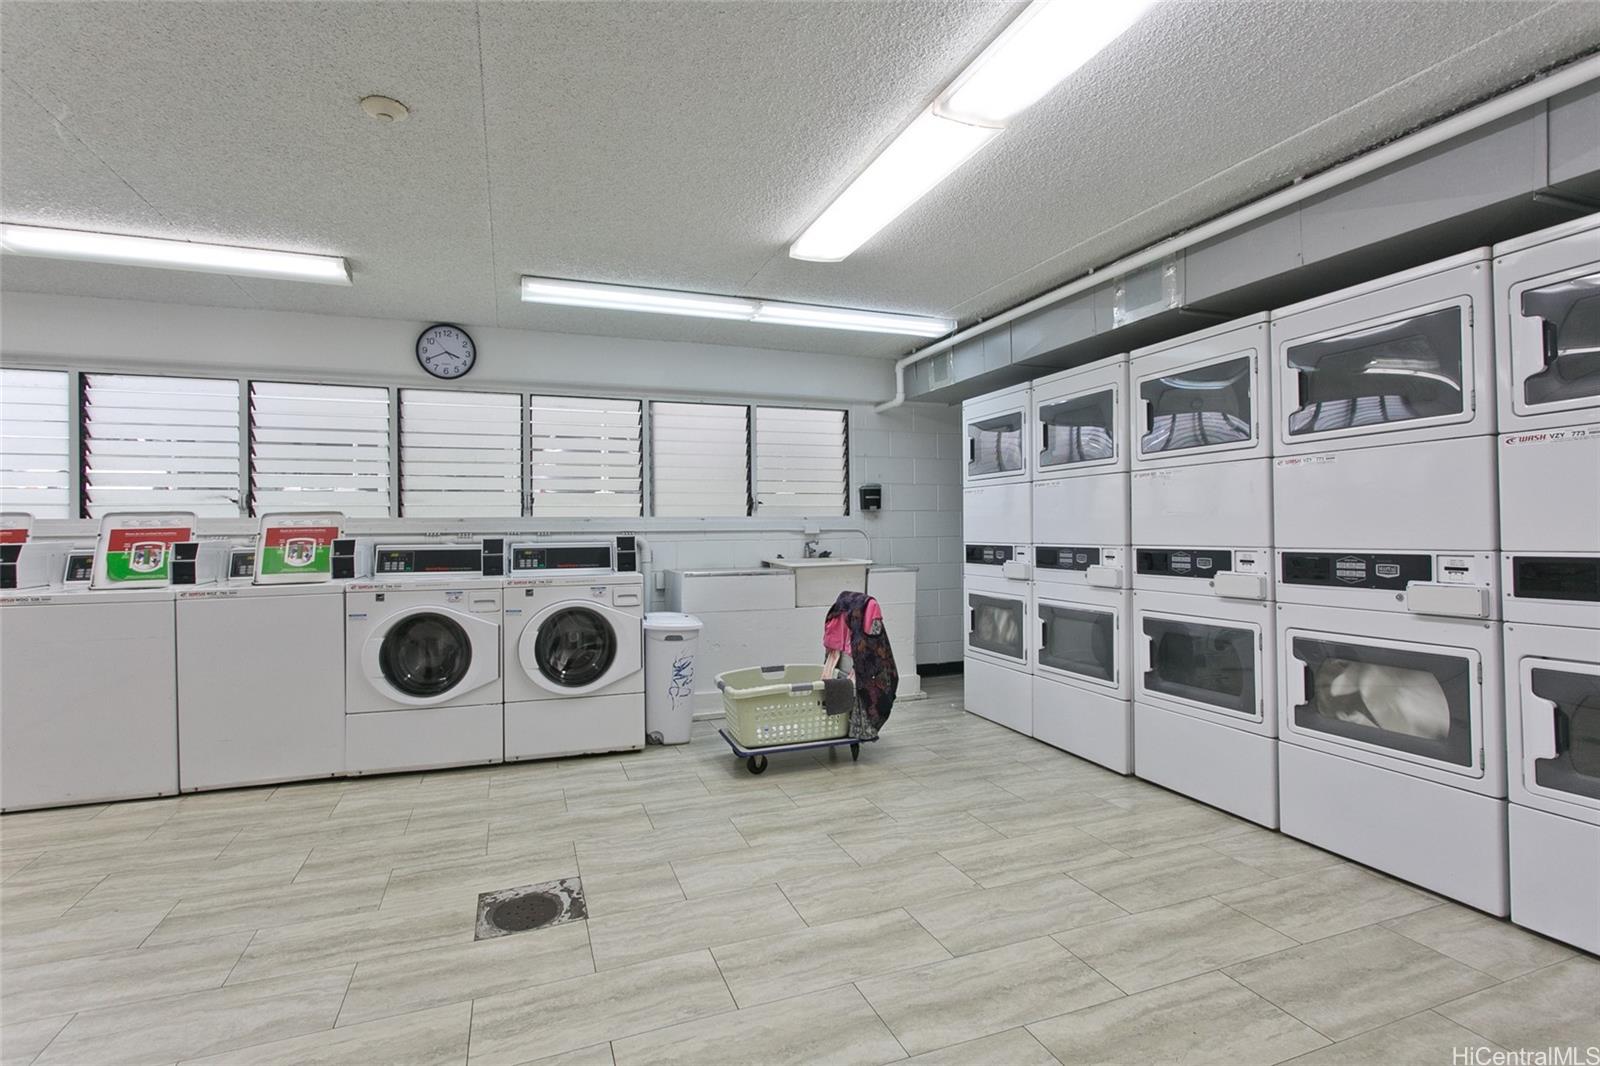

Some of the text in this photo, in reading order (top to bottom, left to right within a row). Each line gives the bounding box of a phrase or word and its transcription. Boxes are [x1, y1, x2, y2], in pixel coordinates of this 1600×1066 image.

[434, 330, 441, 338] 11
[426, 337, 435, 345] 10
[422, 346, 428, 354] 9
[465, 350, 471, 358] 3
[443, 367, 449, 375] 6
[1519, 434, 1547, 443] WASH
